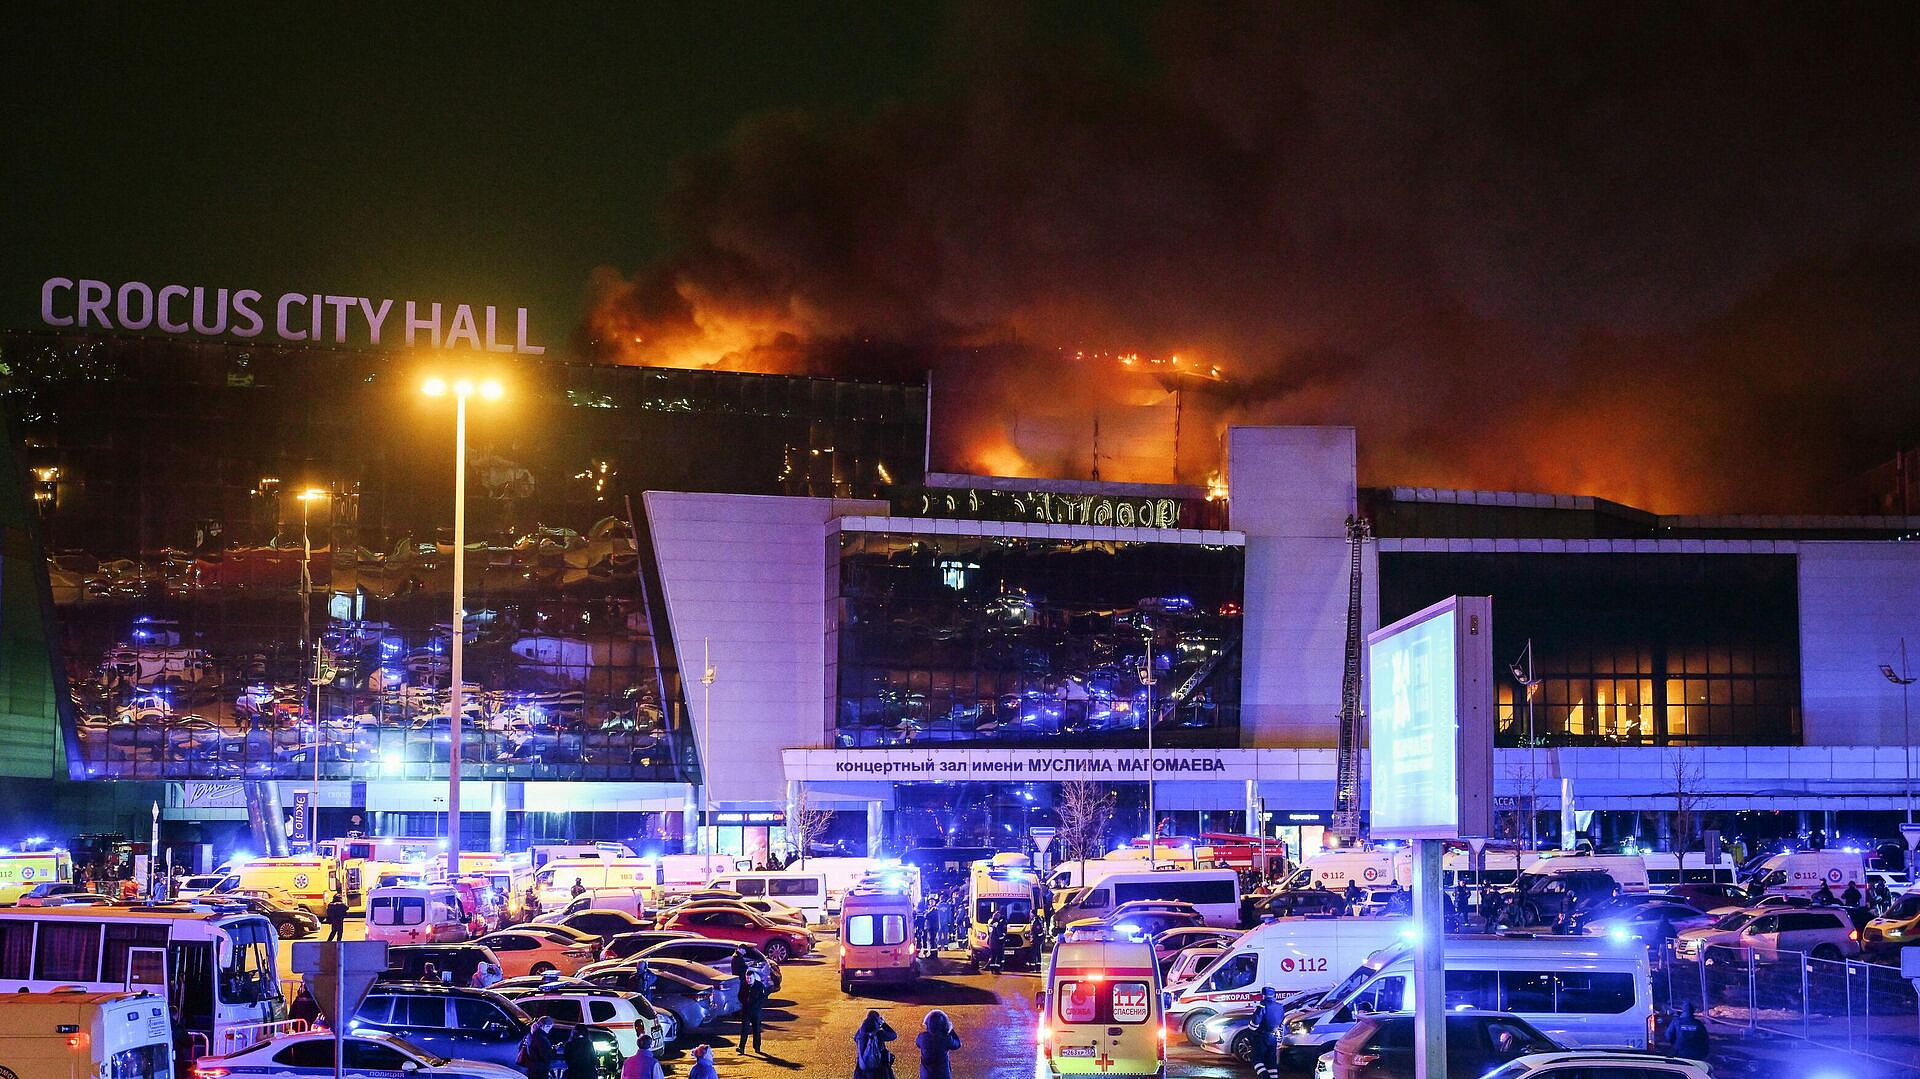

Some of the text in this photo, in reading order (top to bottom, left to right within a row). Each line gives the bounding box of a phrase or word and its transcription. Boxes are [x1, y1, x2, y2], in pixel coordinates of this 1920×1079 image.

[41, 277, 546, 355] CROCUS CITY HALL
[836, 758, 1226, 775] концертный зал имени МУСЛИМА МАГОМАЕВА
[1493, 797, 1515, 806] АССА
[295, 796, 306, 830] Экспо
[1330, 871, 1345, 880] 112
[1802, 872, 1817, 880] 112
[1298, 957, 1328, 972] 112
[1114, 990, 1146, 1007] 112
[1113, 1008, 1147, 1017] СПАСЕНИЯ
[1624, 1038, 1643, 1049] 112
